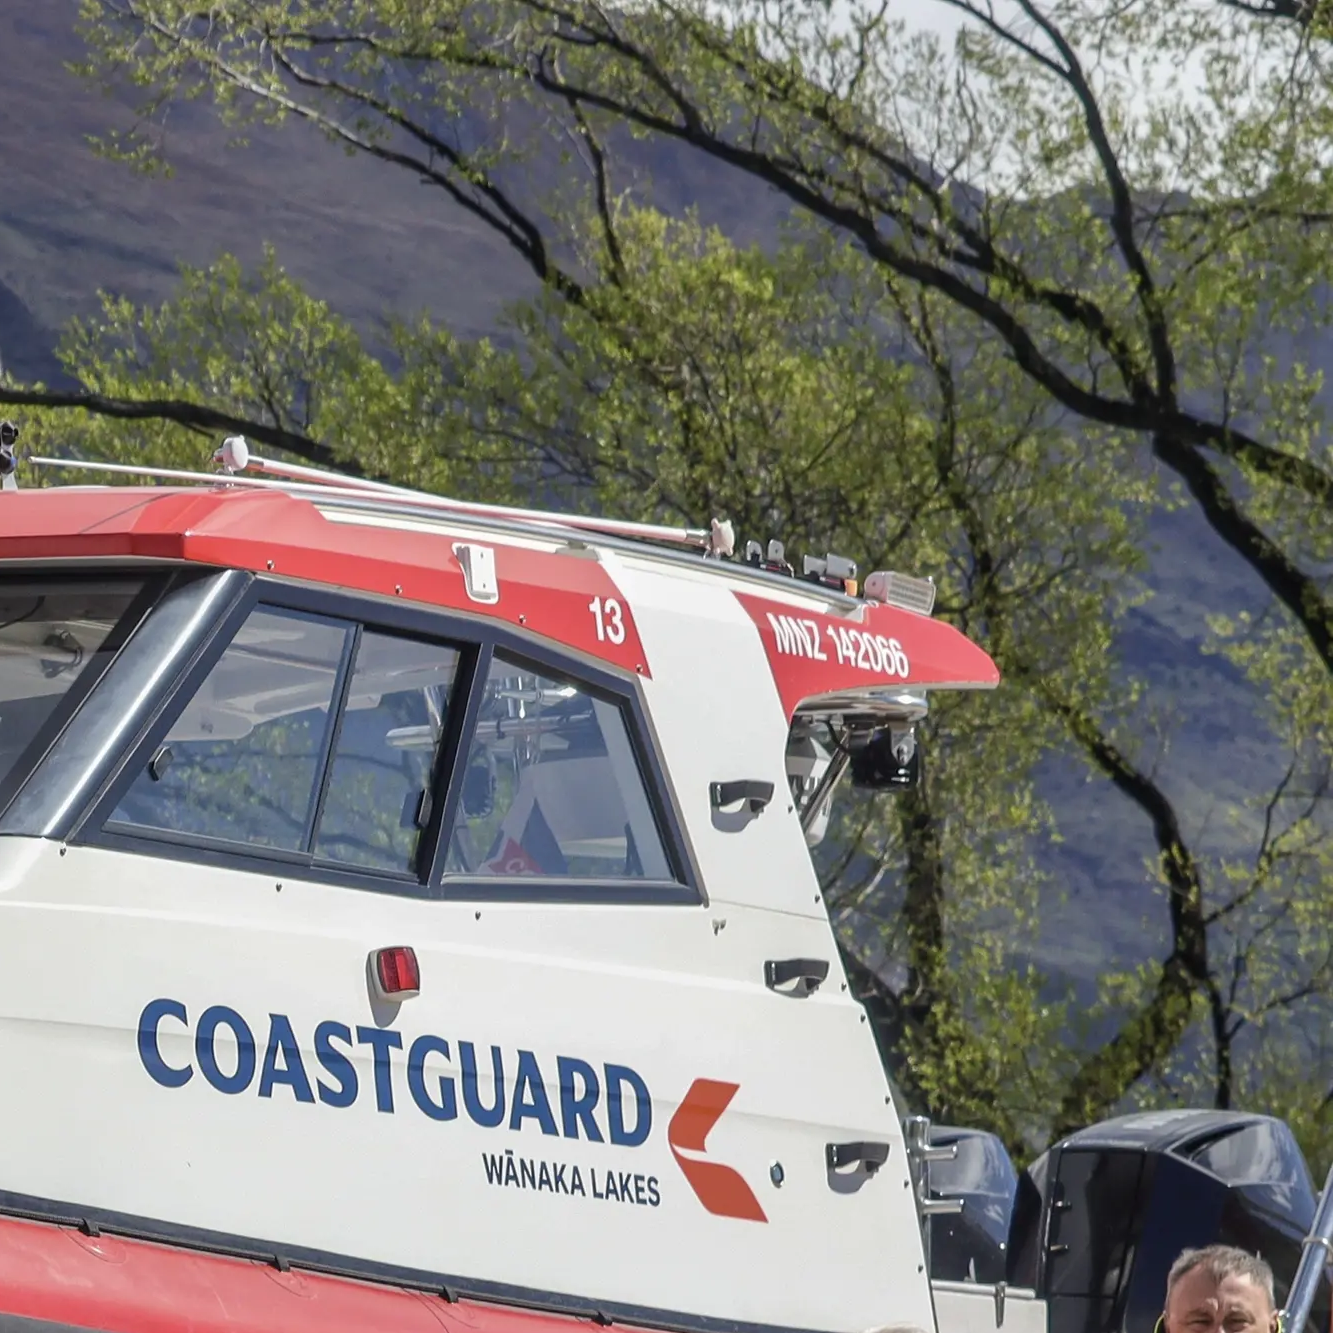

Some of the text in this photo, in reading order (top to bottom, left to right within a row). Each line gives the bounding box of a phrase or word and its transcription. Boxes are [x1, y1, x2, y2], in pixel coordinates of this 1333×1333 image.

[588, 596, 625, 645] 13
[766, 612, 910, 679] MNZ 142066
[137, 997, 653, 1148] COASTGUARD
[482, 1149, 661, 1207] WĀNAKA LAKES
